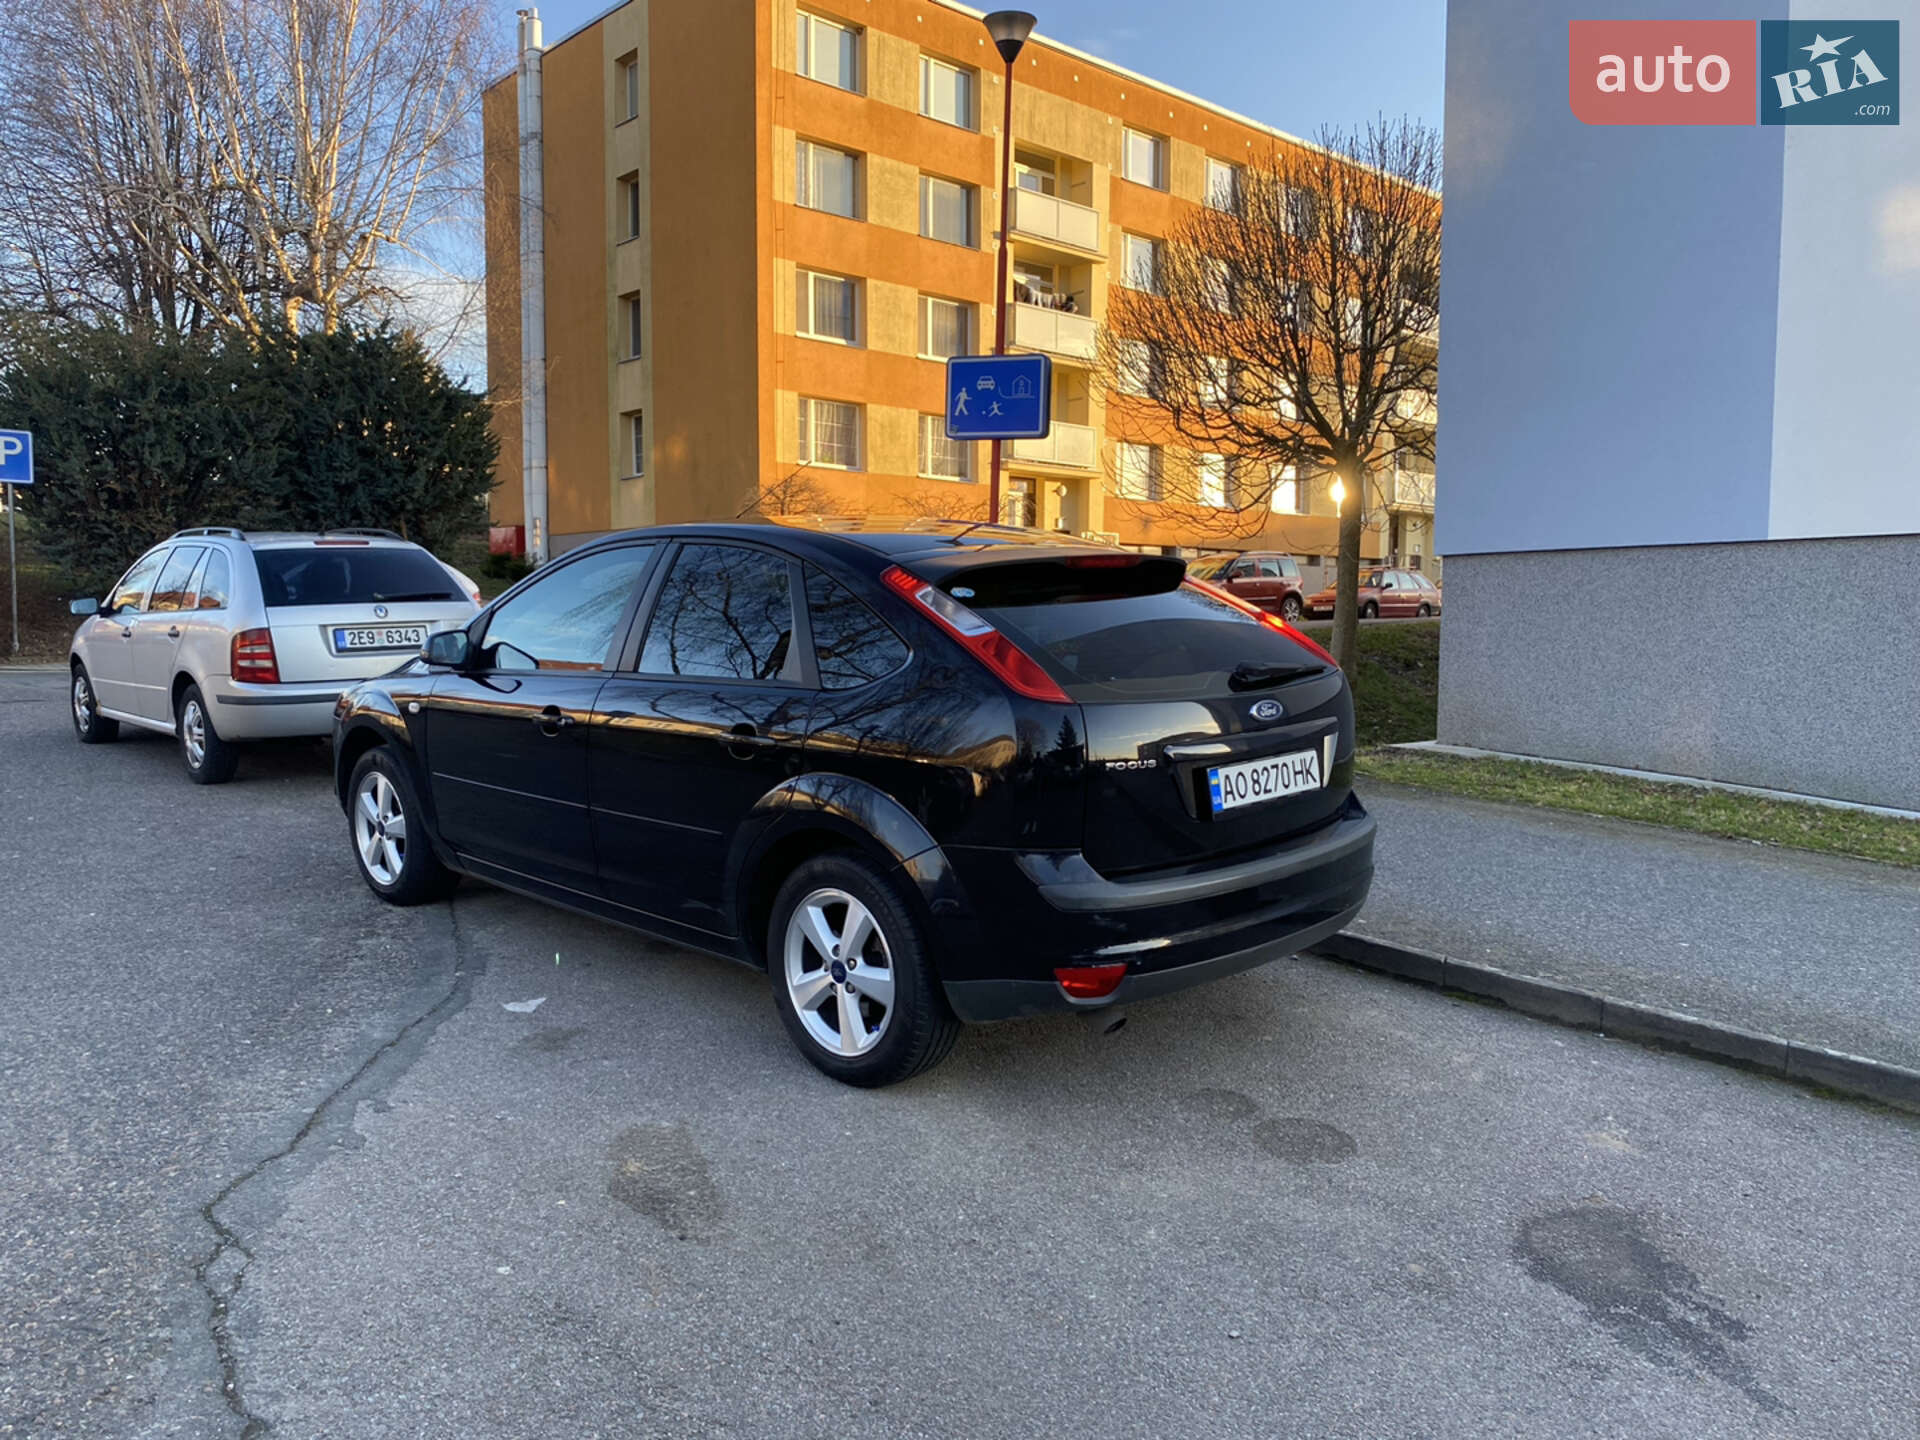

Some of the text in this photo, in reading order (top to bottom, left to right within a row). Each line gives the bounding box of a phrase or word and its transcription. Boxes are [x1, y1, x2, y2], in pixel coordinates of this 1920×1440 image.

[0, 435, 23, 465] P
[348, 629, 420, 646] 2E9 6343
[1105, 759, 1157, 771] FOCUS
[1223, 755, 1317, 803] AO 8270 HK
